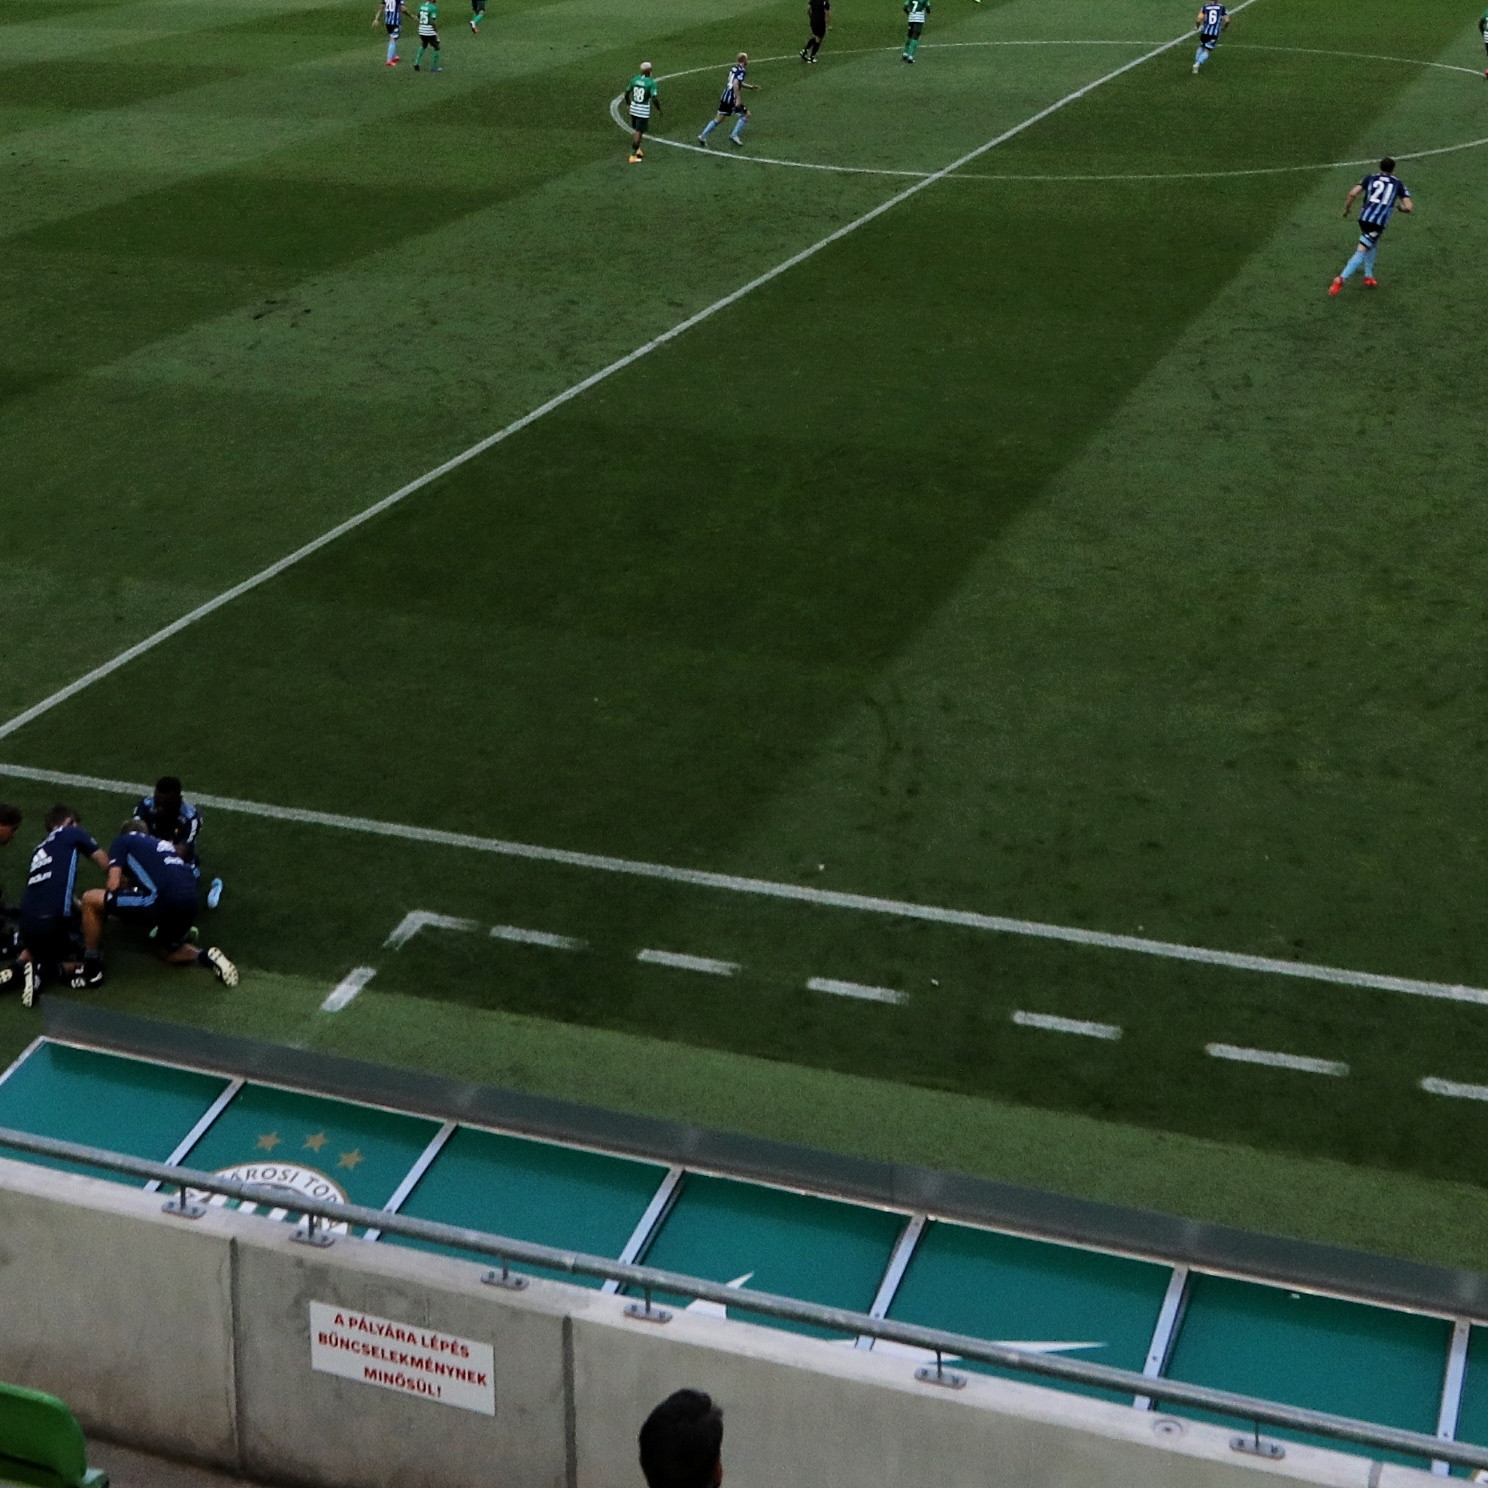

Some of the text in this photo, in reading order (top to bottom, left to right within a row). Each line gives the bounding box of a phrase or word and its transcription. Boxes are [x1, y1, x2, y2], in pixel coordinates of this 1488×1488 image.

[1208, 10, 1217, 25] 6
[1369, 180, 1394, 205] 21
[334, 1313, 469, 1359] A PÁLYÁRA LÉPÉS
